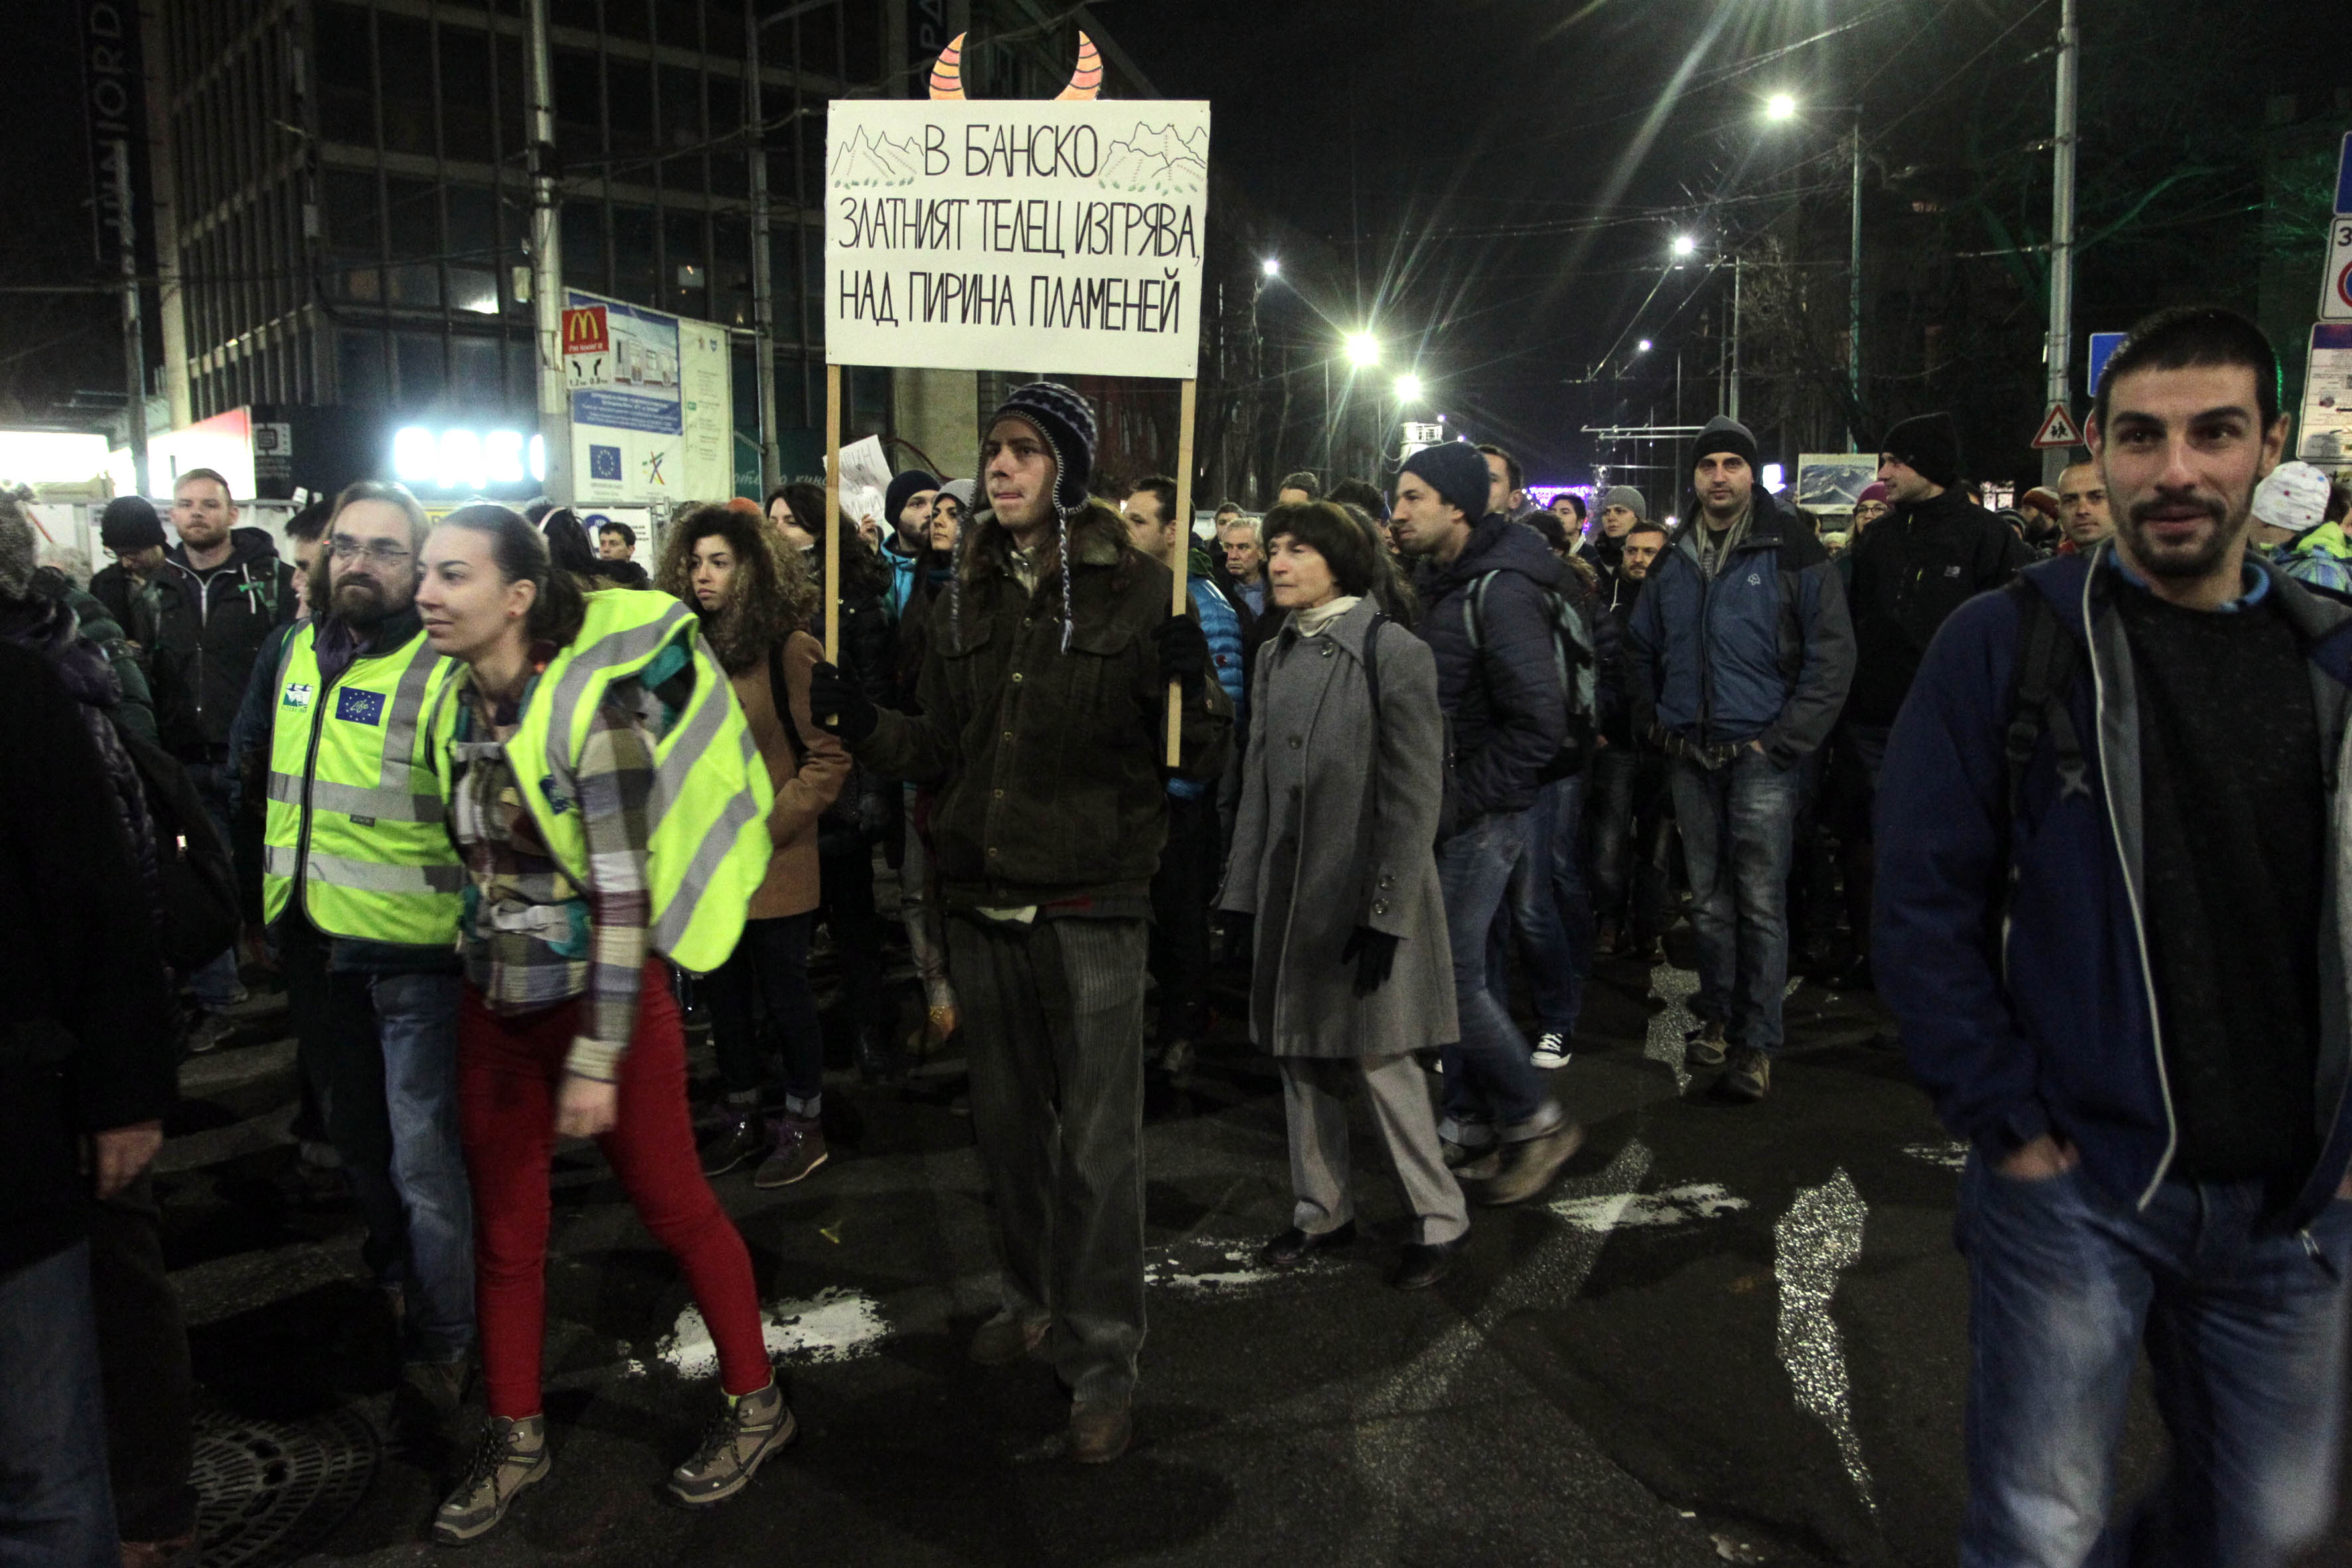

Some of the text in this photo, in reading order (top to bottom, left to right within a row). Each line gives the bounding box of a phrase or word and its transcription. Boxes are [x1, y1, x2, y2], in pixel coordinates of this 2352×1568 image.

[925, 124, 1099, 178] В БАНСКО
[838, 197, 1200, 266] ЗЛАТНИЯТ ТЕЛЕЦ ИЗГРЯВА,
[840, 268, 1180, 333] НАД ПИРИНА ПЛАМЕНЕЙ
[350, 699, 370, 714] Life
